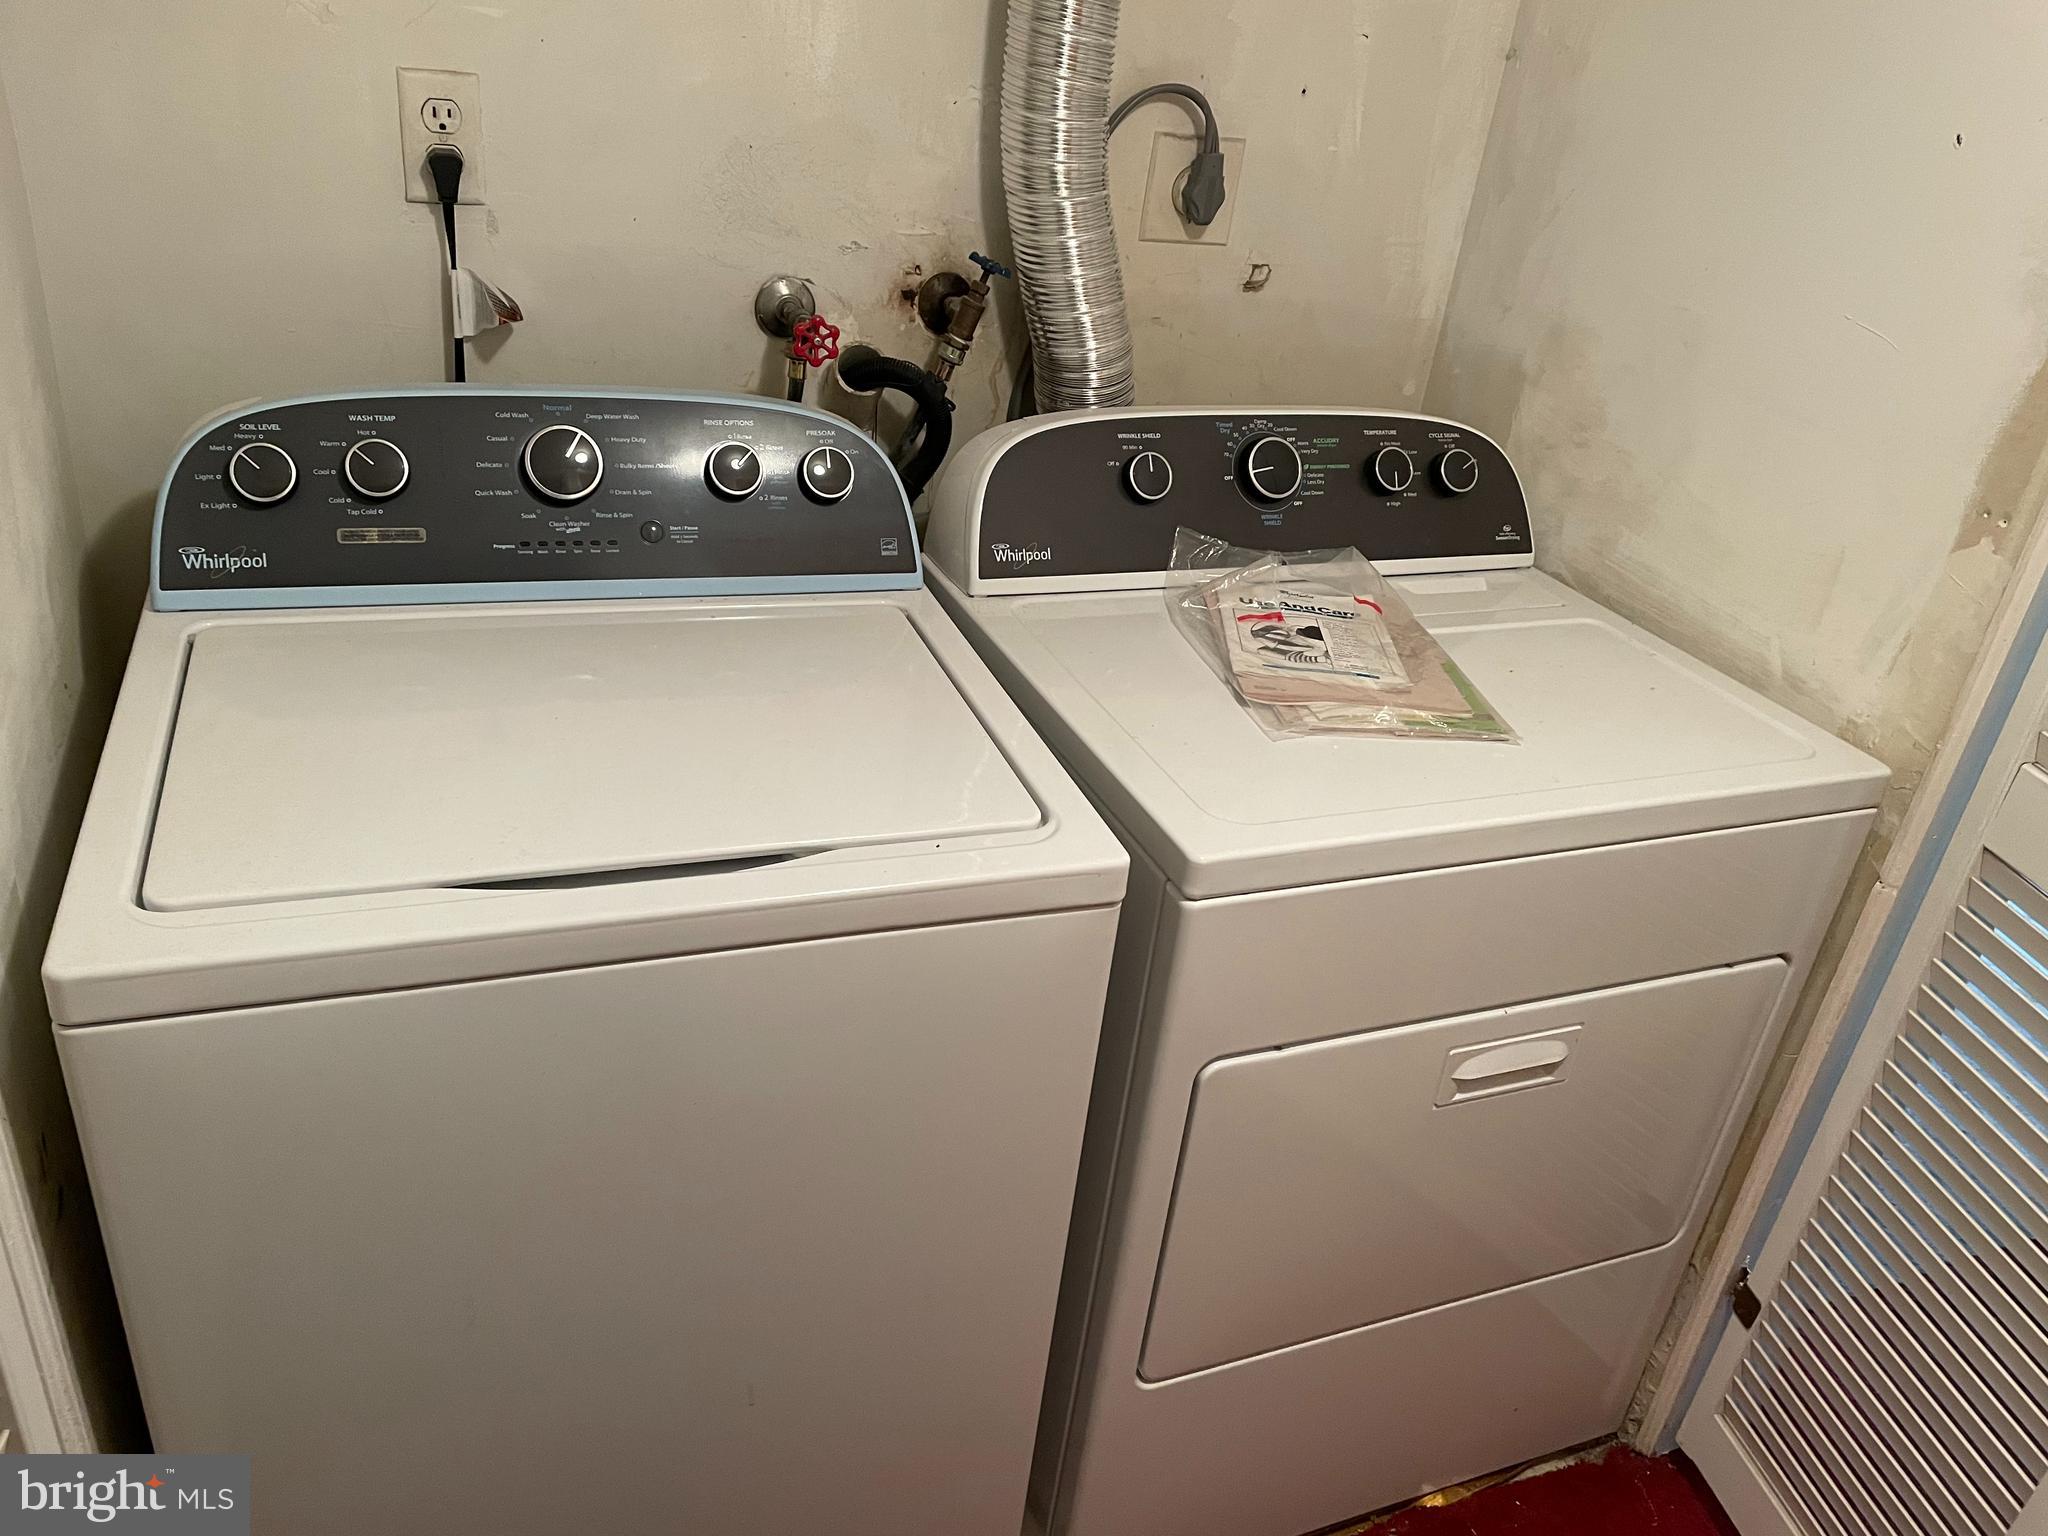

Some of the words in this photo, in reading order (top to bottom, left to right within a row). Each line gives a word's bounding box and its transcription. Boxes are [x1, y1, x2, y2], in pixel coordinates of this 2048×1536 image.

[543, 404, 572, 412] Normal
[348, 414, 372, 422] WASH
[374, 414, 396, 422] TEMP
[586, 413, 602, 421] Deep
[239, 423, 257, 431] SOIL
[258, 423, 282, 431] LEVEL
[723, 419, 754, 427] OPTIONS
[234, 432, 256, 441] Heavy
[611, 436, 630, 444] Heavy
[631, 436, 647, 444] Duty
[195, 473, 215, 482] Light
[474, 489, 494, 497] Quick
[637, 489, 652, 497] Spin
[200, 502, 210, 510] Ex
[210, 502, 231, 511] Light
[347, 508, 360, 517] Tap
[360, 508, 378, 516] Cold
[619, 512, 634, 520] Spin
[548, 520, 566, 528] Clean
[566, 520, 591, 528] Washer
[993, 548, 1051, 565] Whirlpool
[182, 553, 267, 573] Whirlpool
